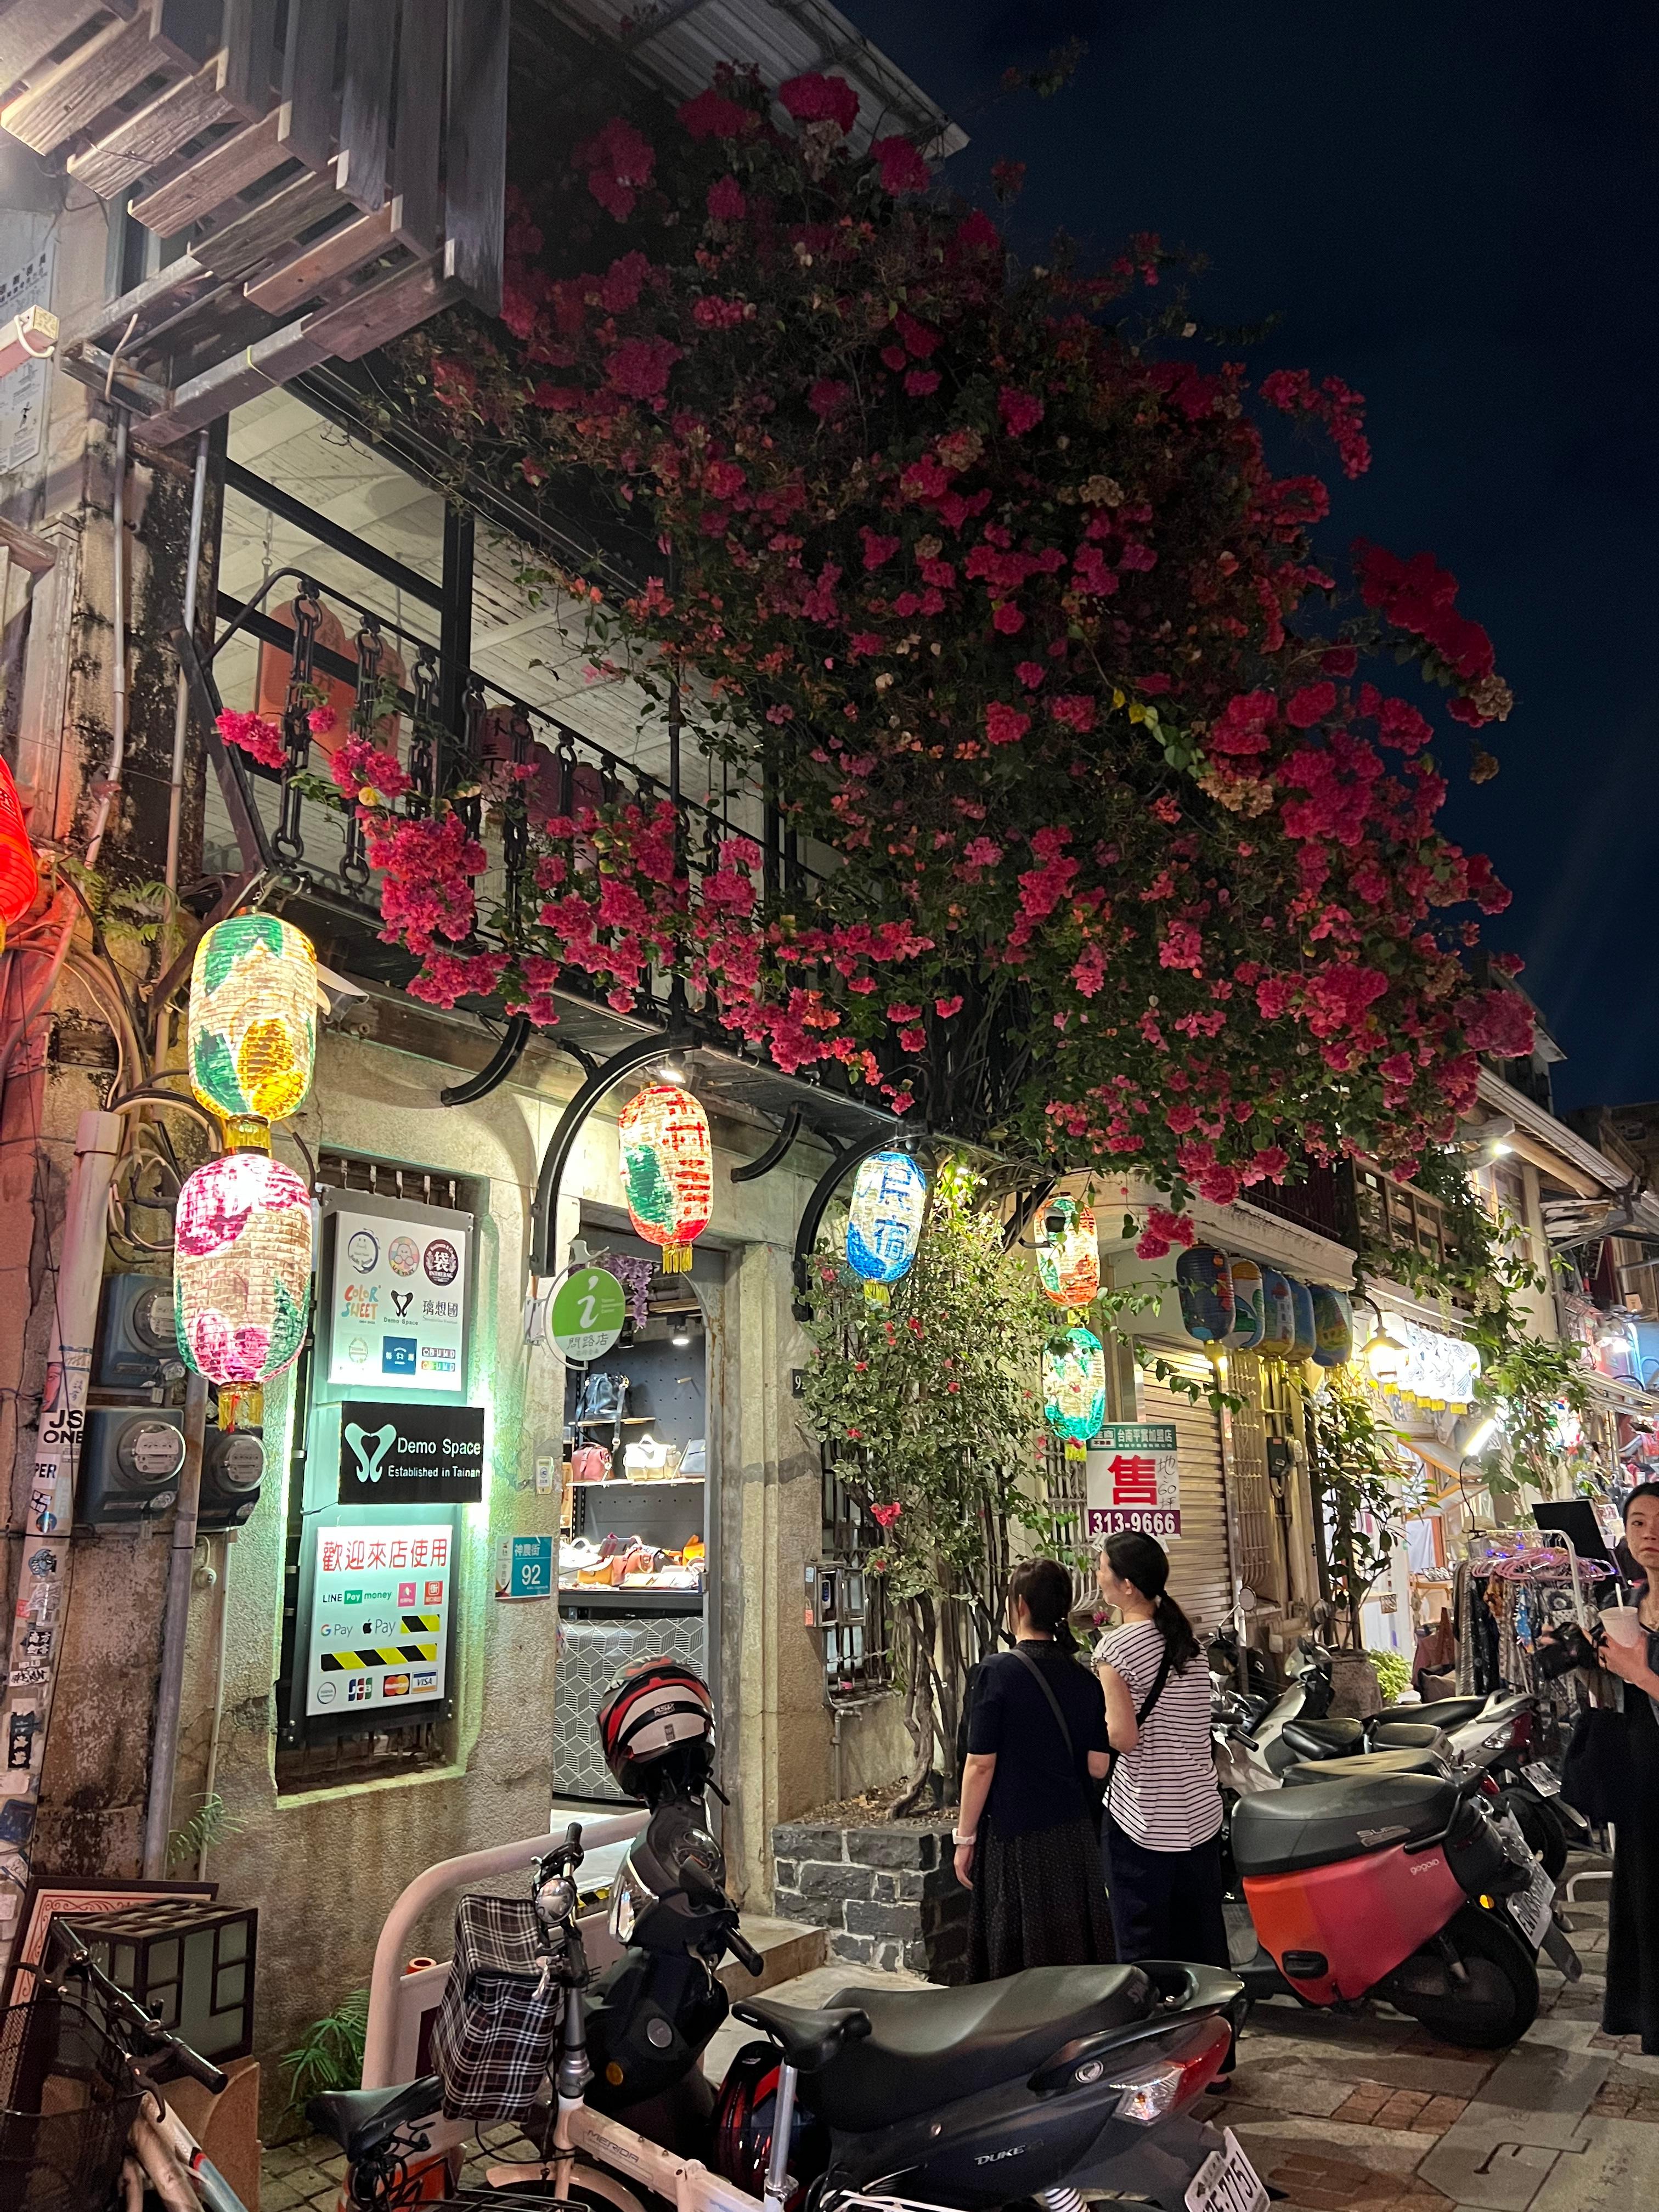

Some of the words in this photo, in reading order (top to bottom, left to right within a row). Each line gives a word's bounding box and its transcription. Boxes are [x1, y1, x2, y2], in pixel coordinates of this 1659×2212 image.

[873, 1165, 913, 1261] 民宿
[433, 1251, 451, 1272] 袋
[567, 1333, 609, 1350] 問路店
[398, 1437, 436, 1454] Demo
[442, 1438, 481, 1458] Space
[388, 1465, 438, 1477] Established
[442, 1468, 450, 1477] in
[452, 1466, 481, 1477] Tainan
[1107, 1454, 1157, 1505] 售
[1093, 1513, 1175, 1534] 313-9666
[323, 1538, 447, 1572] 歡迎來店使用
[522, 1564, 541, 1585] 92
[323, 1594, 342, 1602] LINE
[346, 1593, 360, 1601] Pay
[364, 1592, 392, 1600] money
[334, 1624, 353, 1638] Pay
[375, 1619, 396, 1637] Pay
[348, 1681, 372, 1697] JCB
[416, 1677, 432, 1686] VISA
[588, 2130, 639, 2163] MERIDA
[974, 2145, 1026, 2165] DUKE
